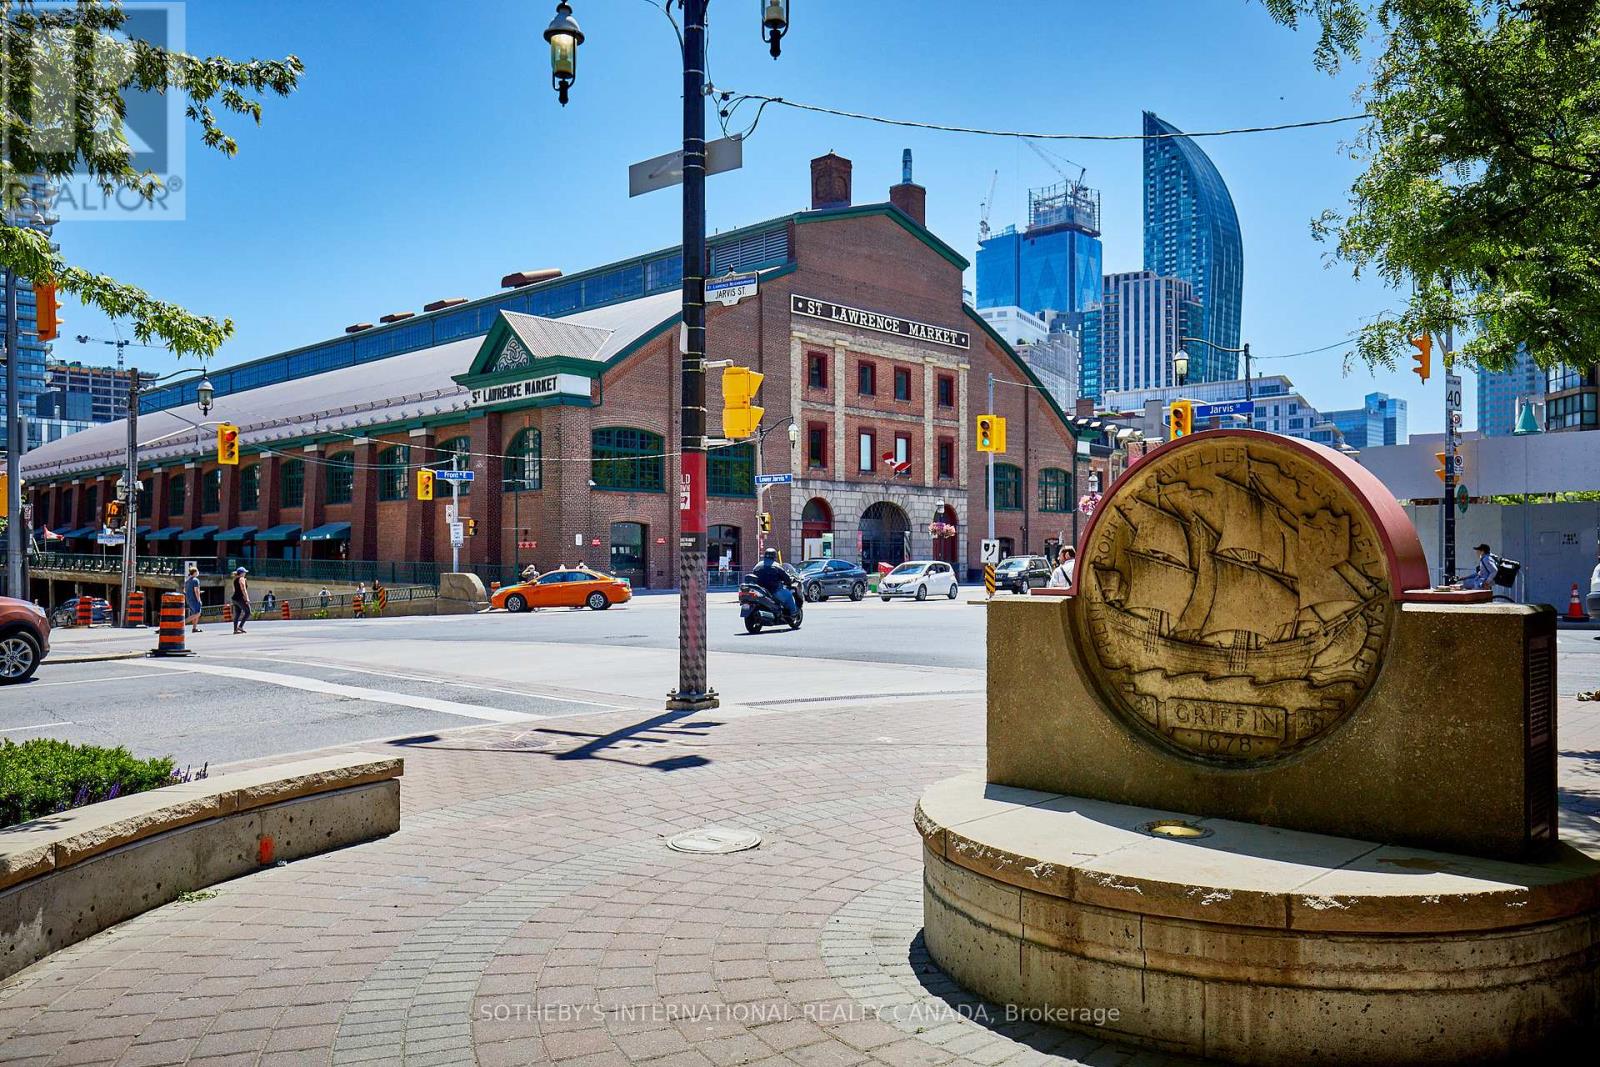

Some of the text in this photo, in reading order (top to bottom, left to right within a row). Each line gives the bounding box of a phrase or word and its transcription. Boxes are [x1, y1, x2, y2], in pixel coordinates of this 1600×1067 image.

[715, 288, 736, 299] JARVIS
[832, 306, 900, 332] LAWRENCE
[909, 323, 958, 344] MARKET
[484, 383, 522, 402] LAWRENCE
[525, 376, 558, 396] MARKET
[1447, 390, 1461, 407] 40
[1210, 405, 1234, 414] Jarvis
[680, 473, 691, 484] LD
[1145, 447, 1248, 490] CAVELIER
[1175, 703, 1279, 736] GRIFFIN
[1199, 732, 1252, 754] 1678
